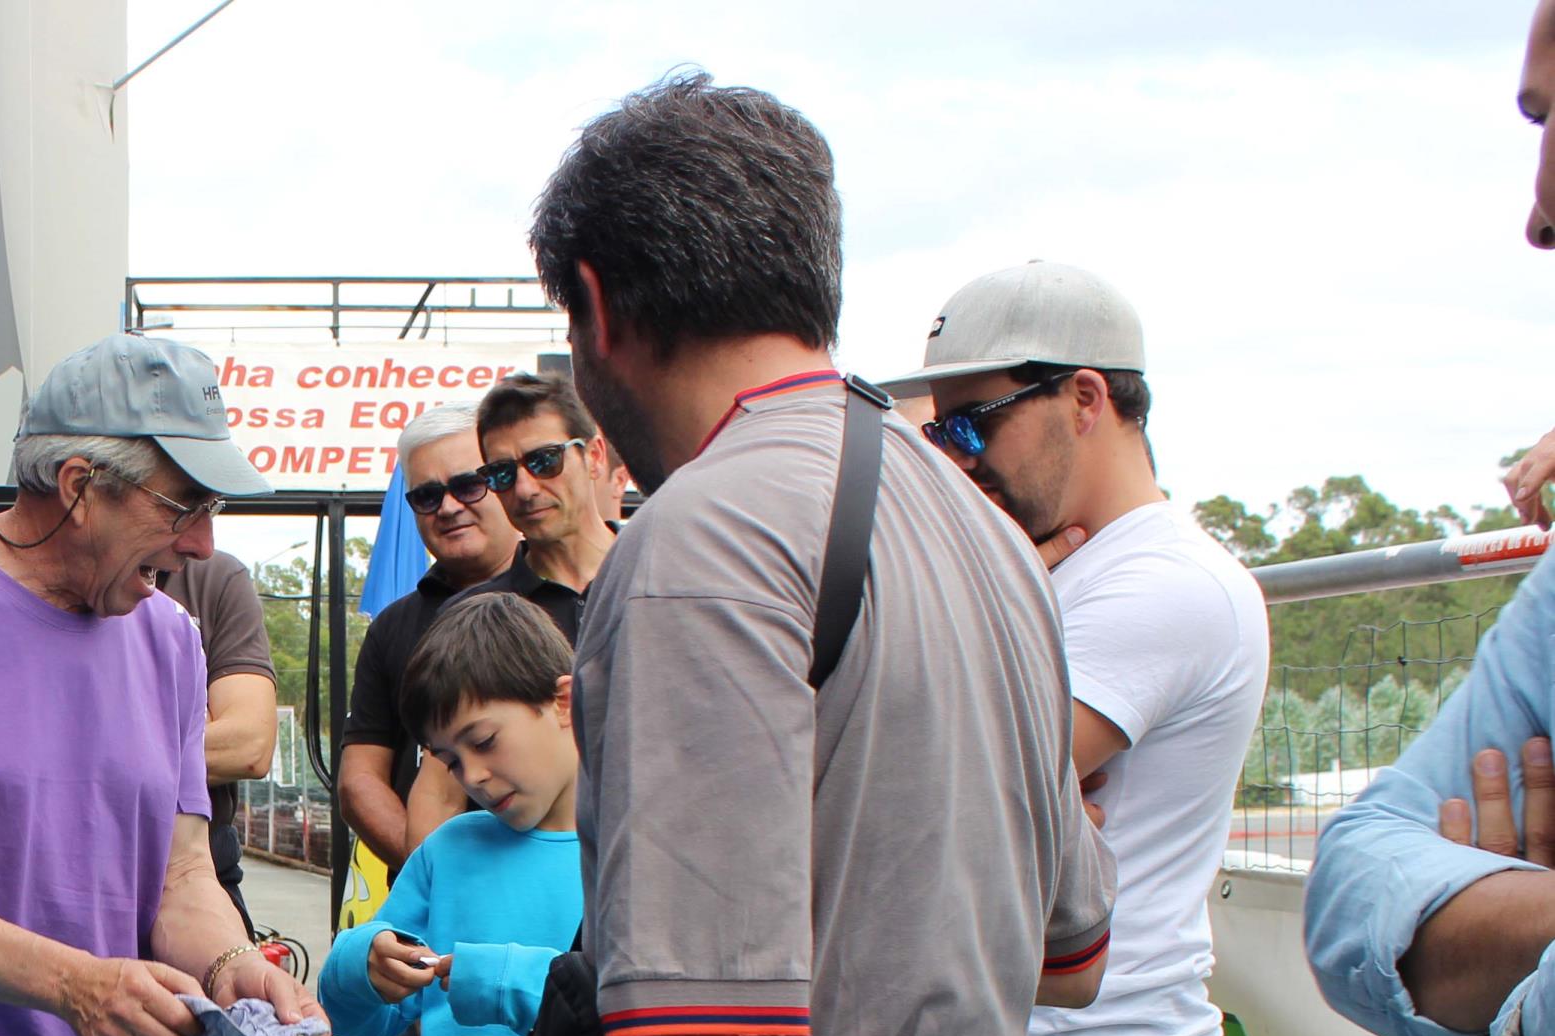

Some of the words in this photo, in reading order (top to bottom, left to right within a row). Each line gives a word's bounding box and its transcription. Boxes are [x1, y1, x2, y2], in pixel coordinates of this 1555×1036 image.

[296, 358, 515, 388] conhecer
[225, 406, 325, 428] ossa
[238, 445, 398, 475] OMPET
